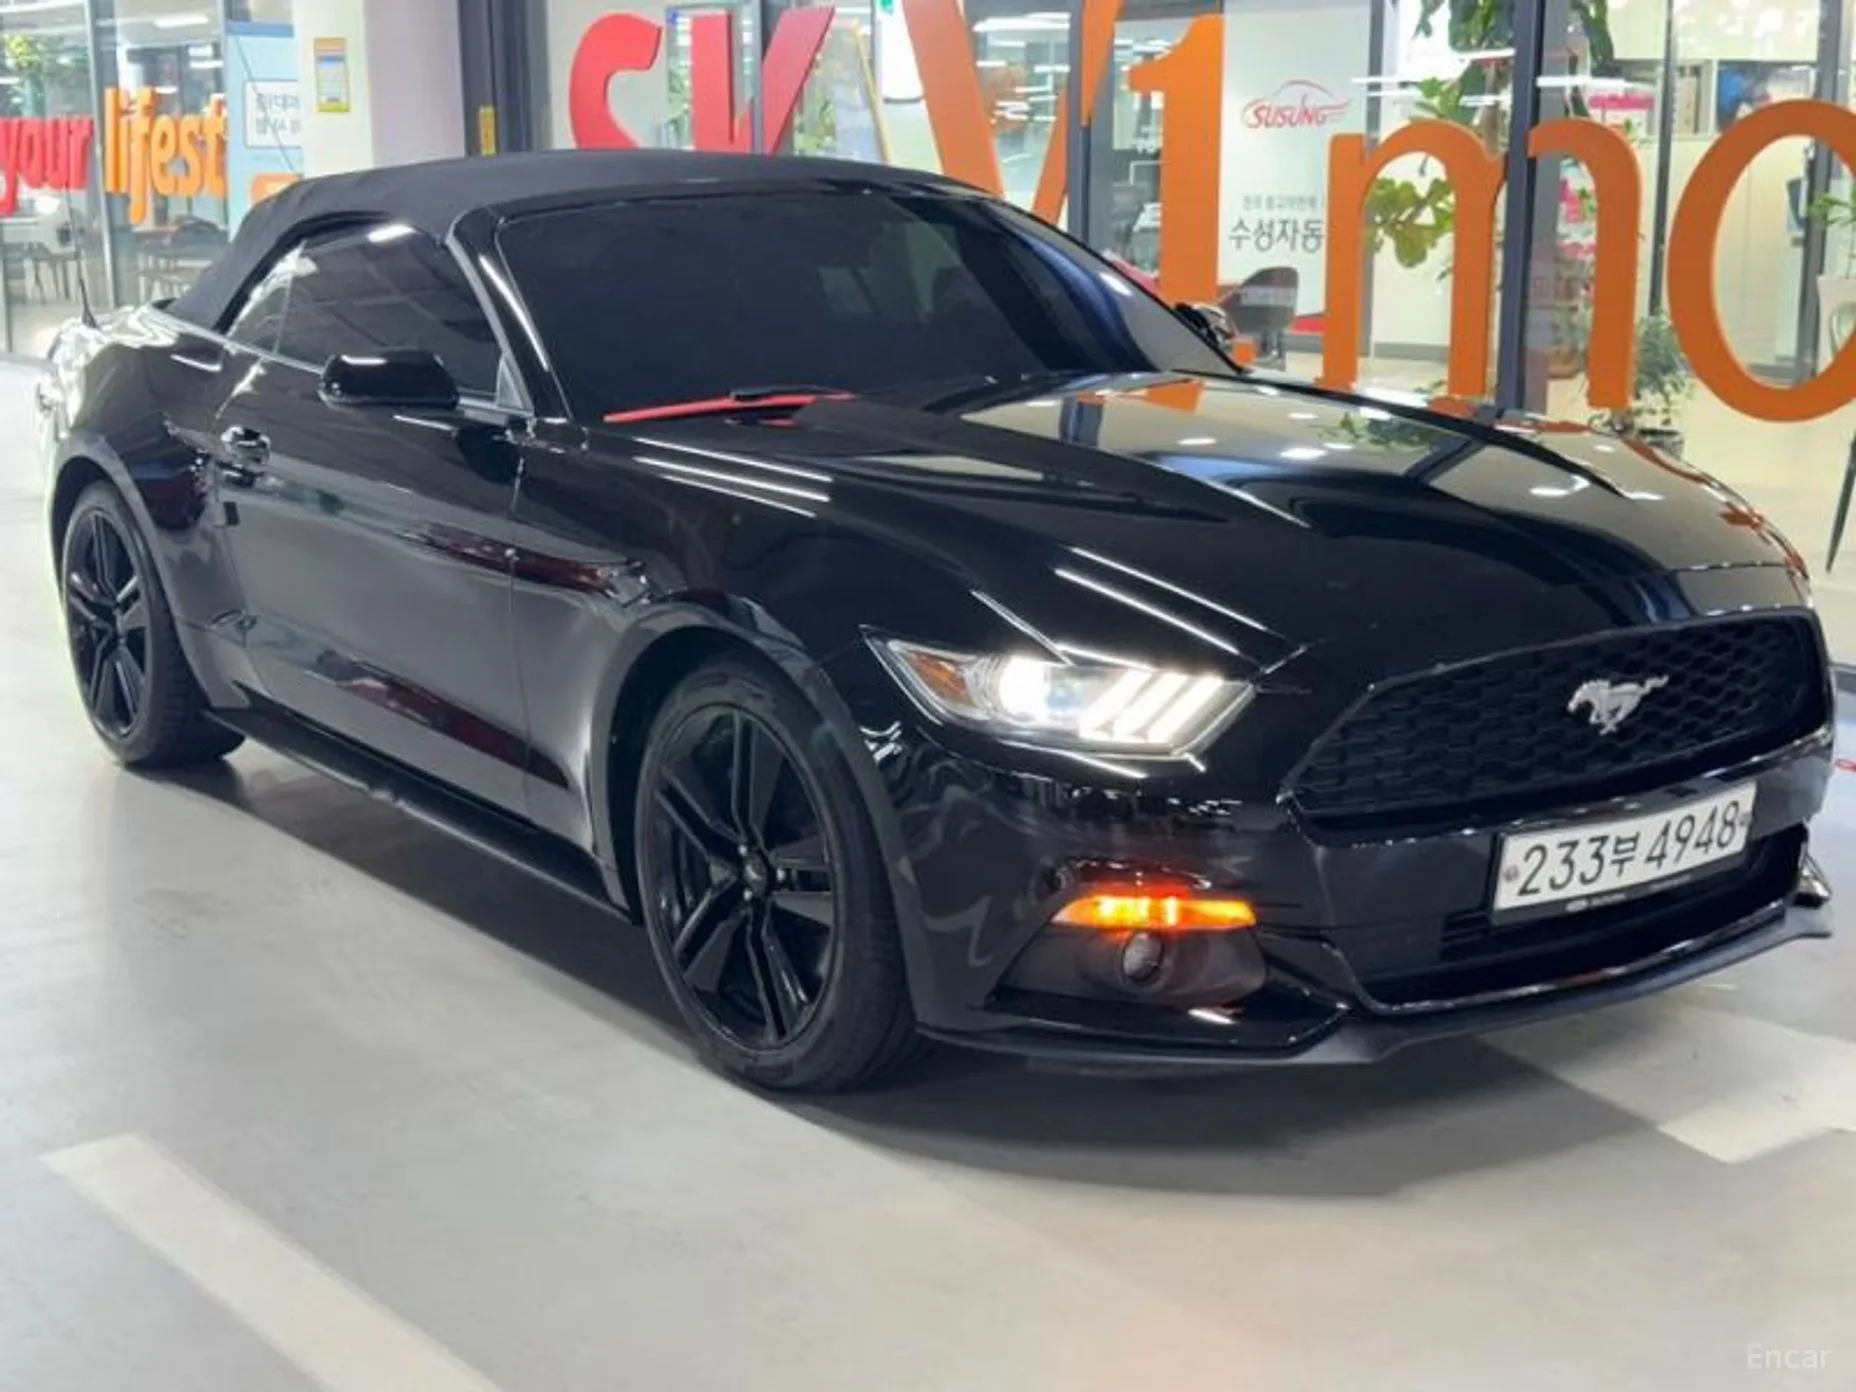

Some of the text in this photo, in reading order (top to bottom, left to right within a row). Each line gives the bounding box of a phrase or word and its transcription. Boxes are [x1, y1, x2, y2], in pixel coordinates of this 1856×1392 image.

[1243, 100, 1338, 130] SUSUNG
[0, 116, 94, 216] your
[1228, 217, 1323, 253] 수성자동
